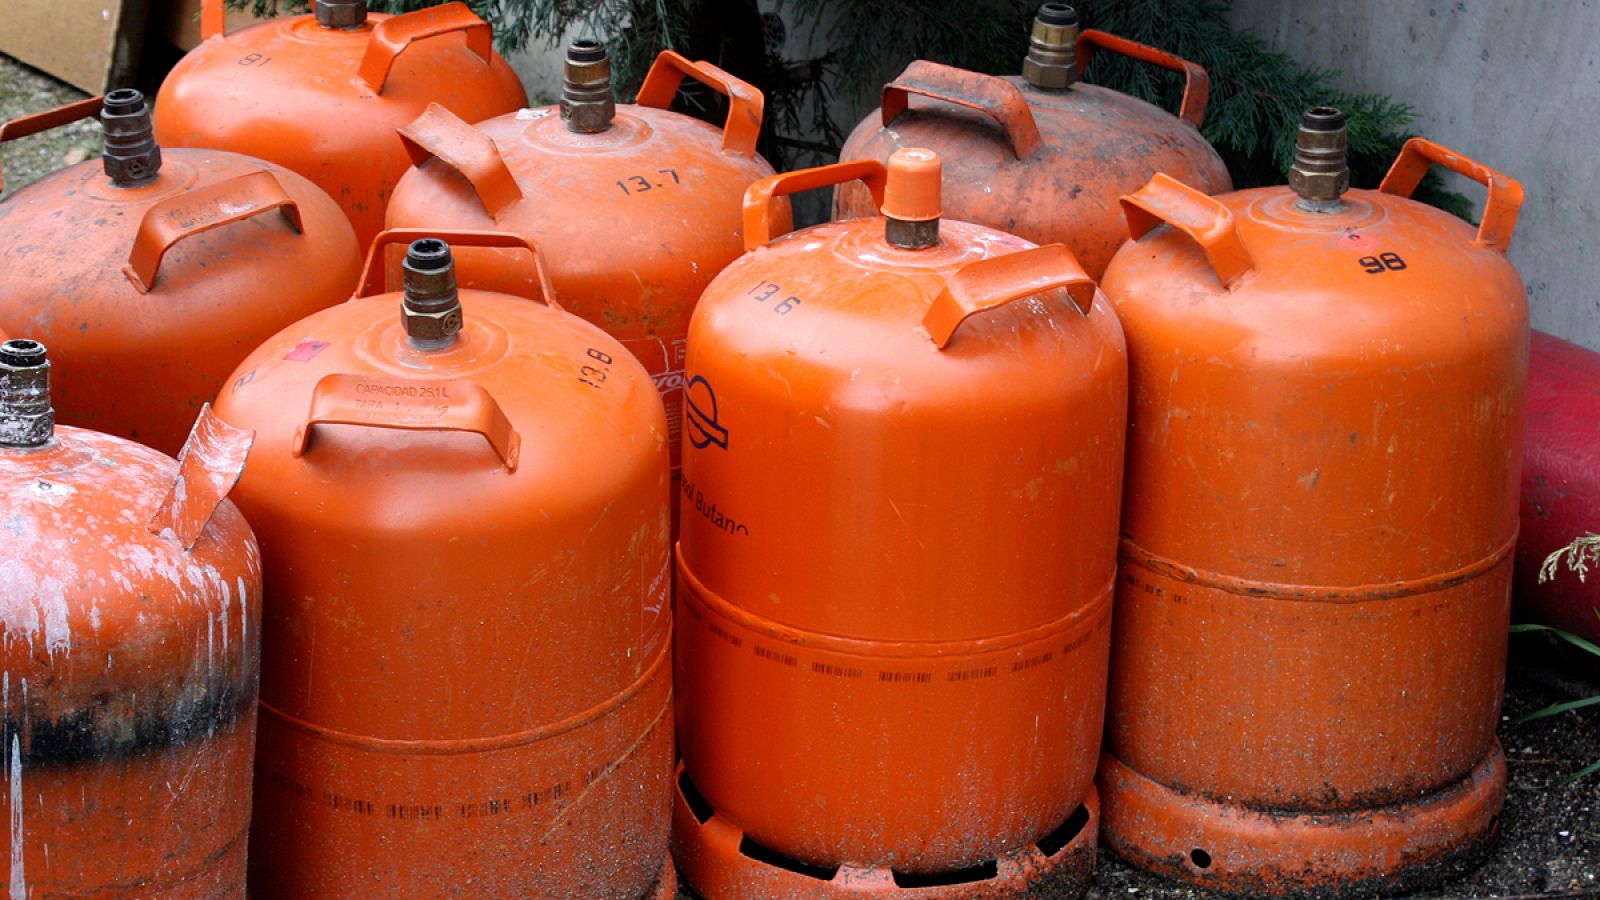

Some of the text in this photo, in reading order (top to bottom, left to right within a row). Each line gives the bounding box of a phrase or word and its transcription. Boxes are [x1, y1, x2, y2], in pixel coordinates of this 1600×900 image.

[616, 169, 680, 196] 13.7
[1359, 252, 1407, 274] 98
[355, 383, 418, 397] CAPACIDAD
